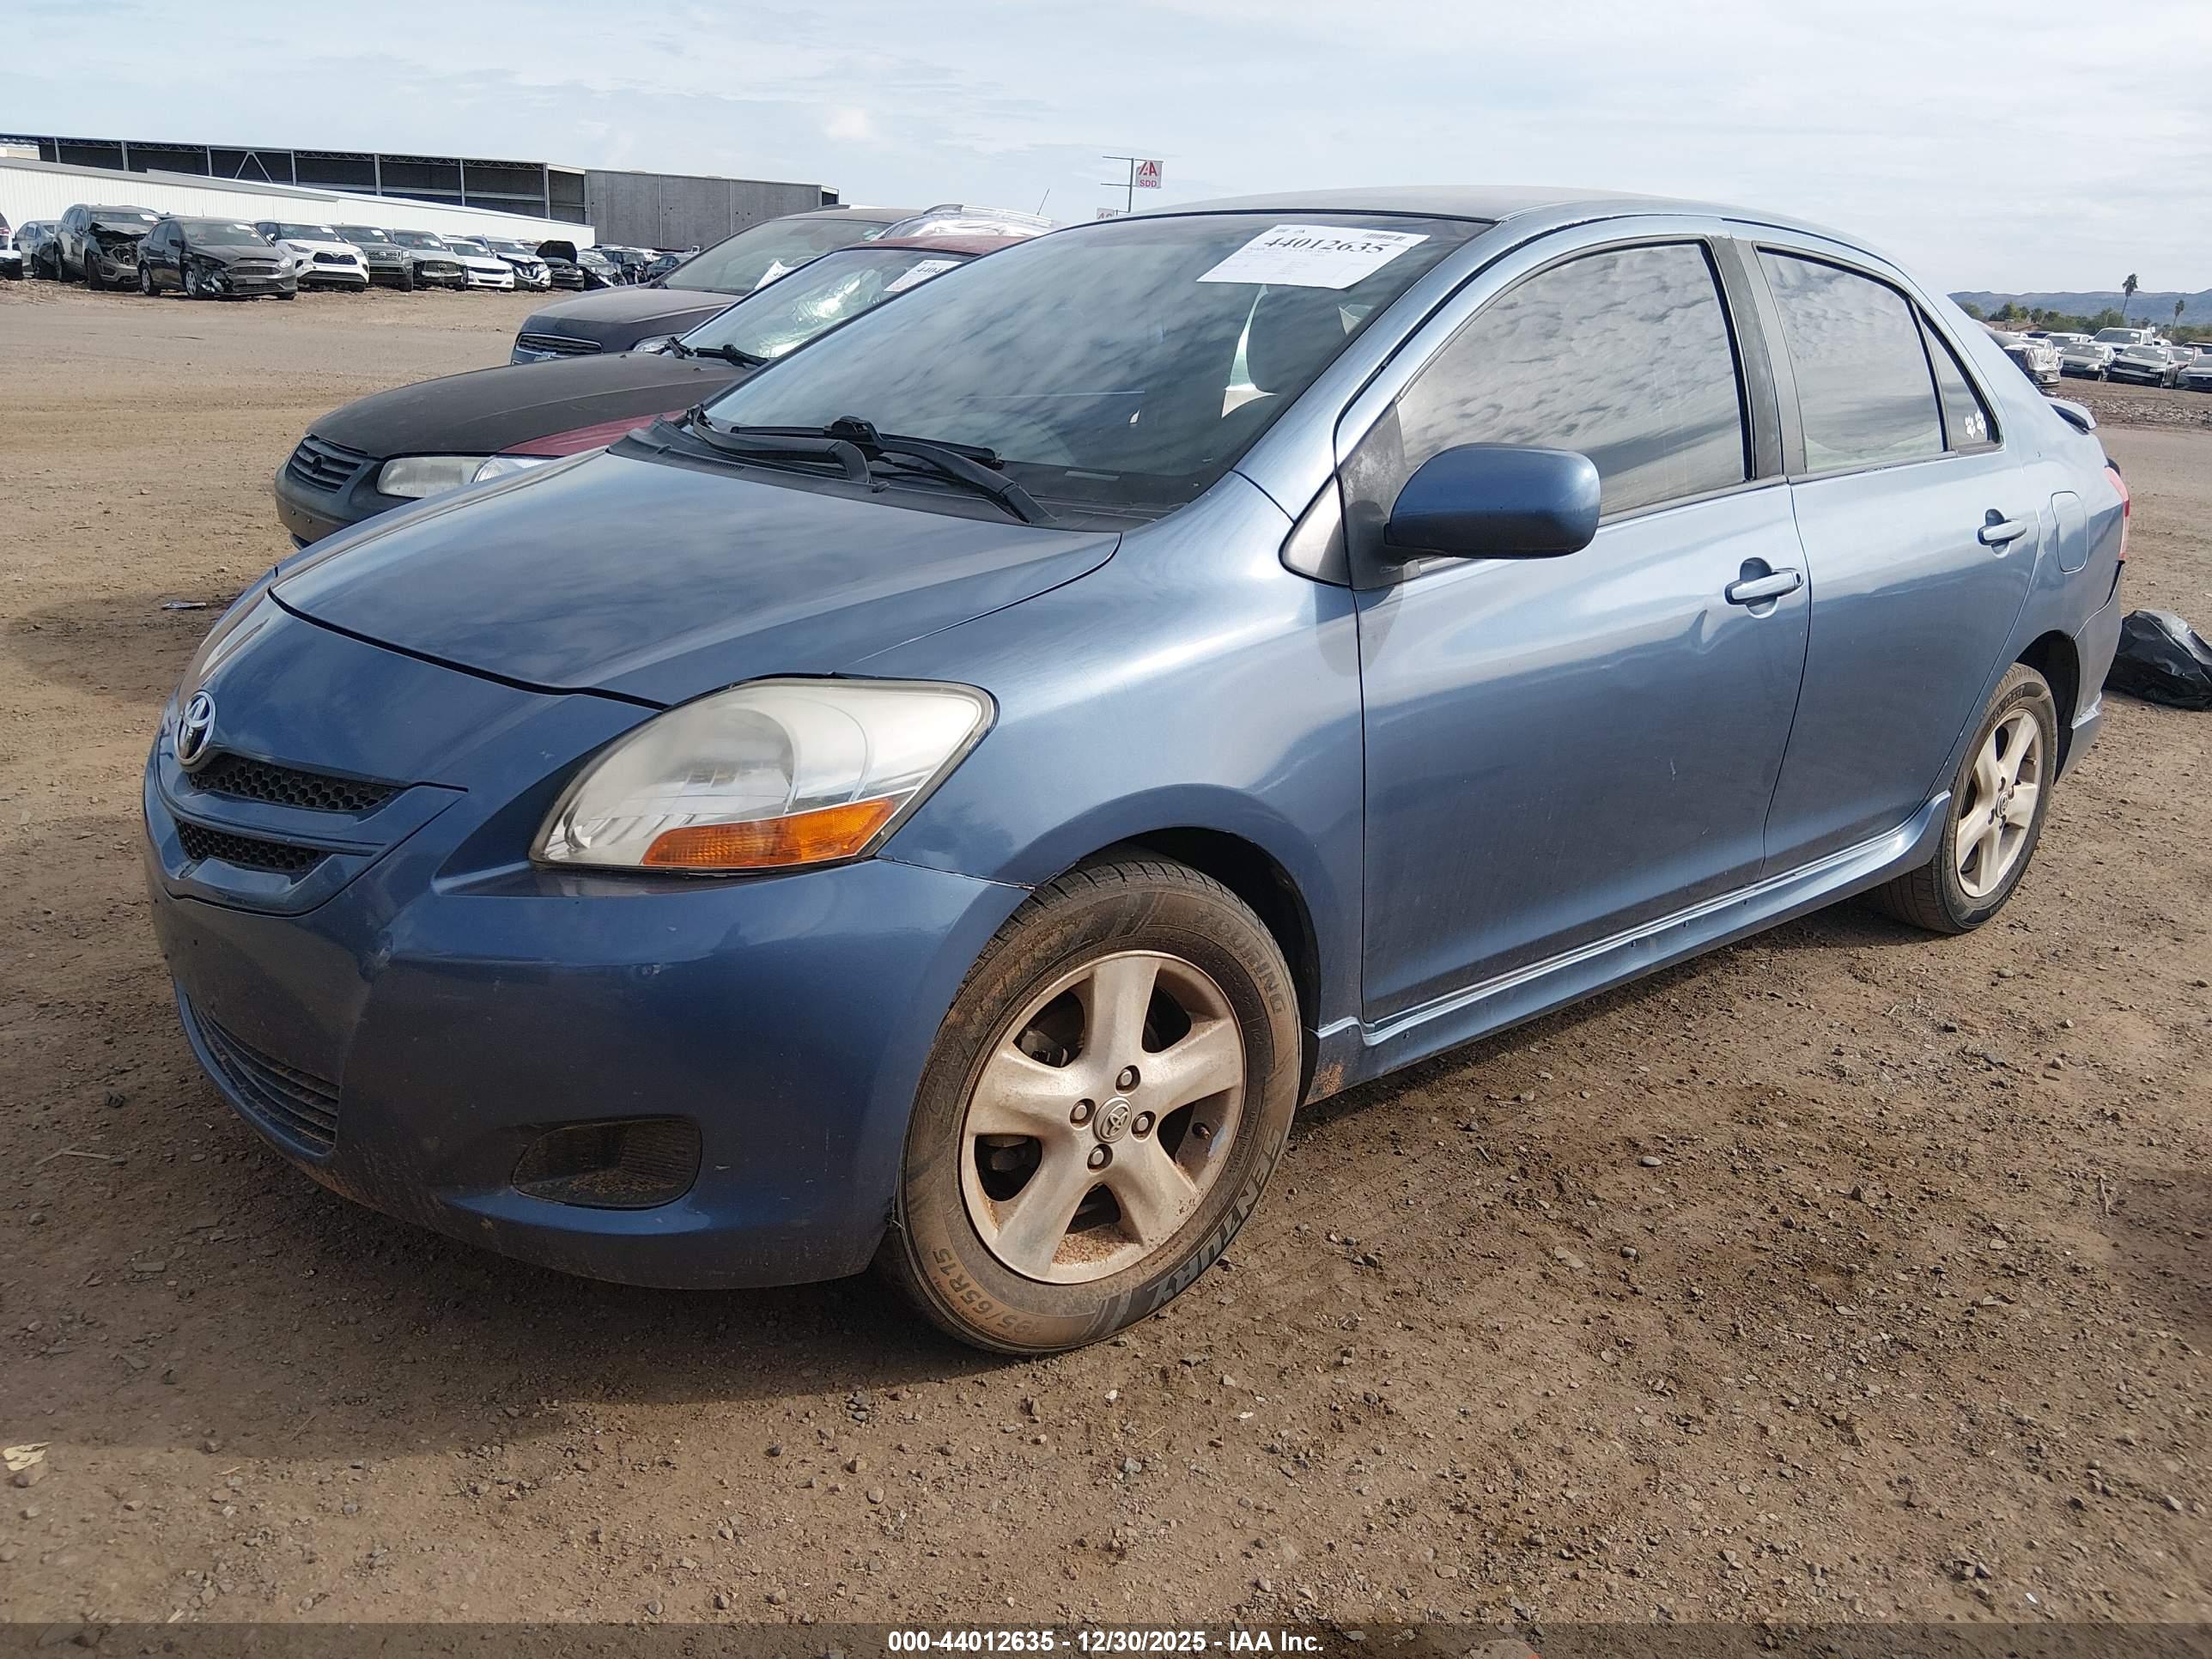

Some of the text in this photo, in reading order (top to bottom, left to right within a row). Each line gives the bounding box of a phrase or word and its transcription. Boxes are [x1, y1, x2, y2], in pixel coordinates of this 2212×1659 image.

[1139, 179, 1158, 188] SDD
[1263, 236, 1390, 254] 44012635
[932, 1247, 1041, 1338] 95/65R15
